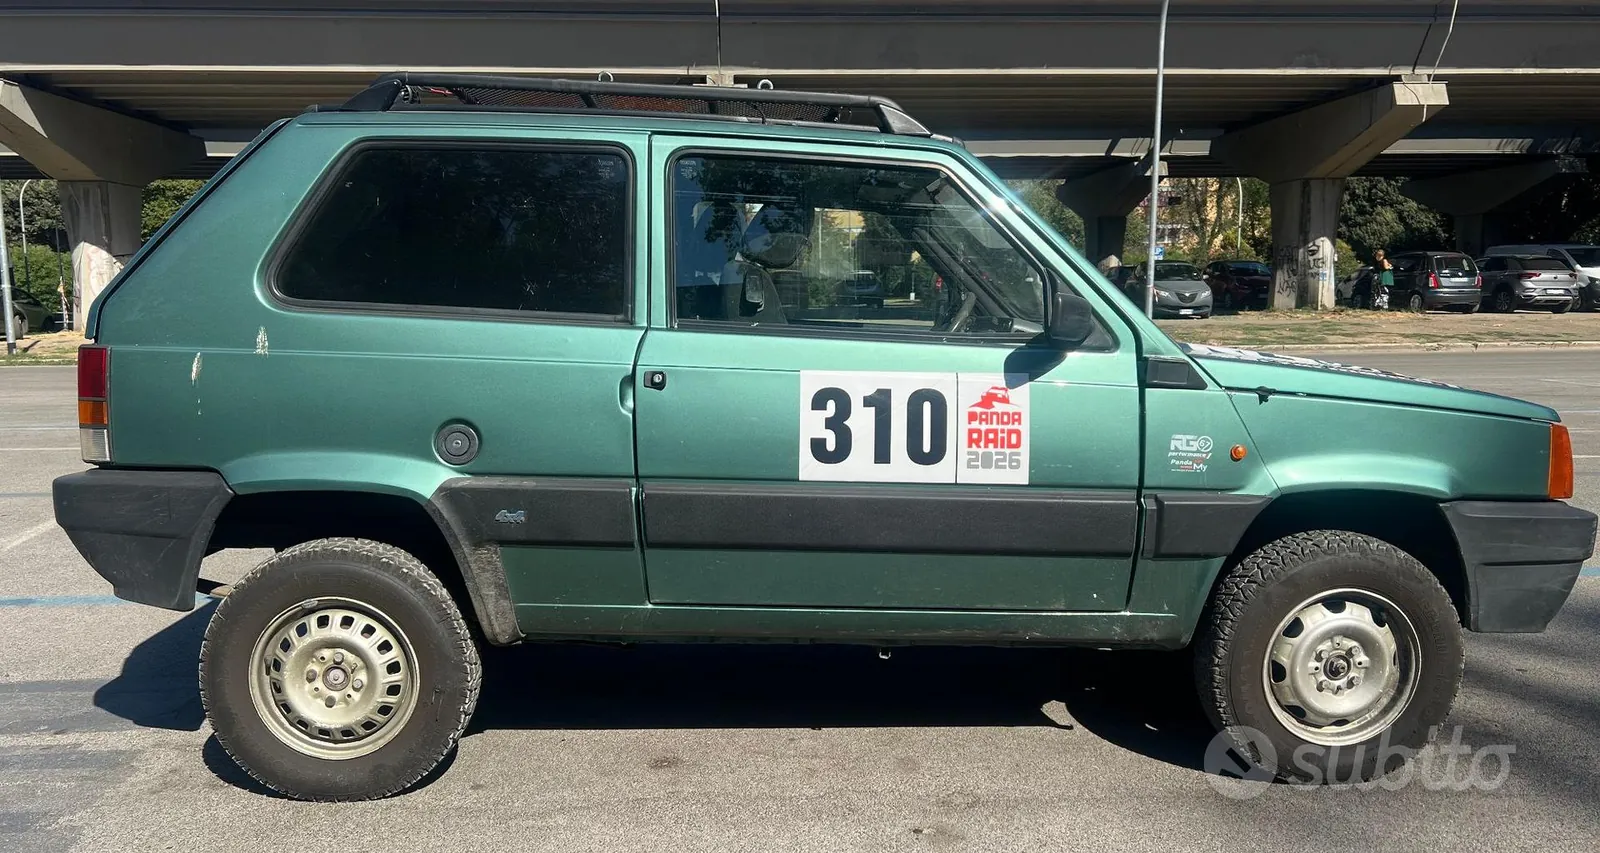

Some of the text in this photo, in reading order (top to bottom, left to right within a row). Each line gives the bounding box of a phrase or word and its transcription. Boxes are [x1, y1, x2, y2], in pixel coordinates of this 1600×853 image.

[967, 411, 1022, 426] PANDA
[810, 387, 948, 466] 310
[966, 451, 1021, 470] 2026
[1193, 463, 1208, 472] My
[495, 509, 525, 524] 4x4
